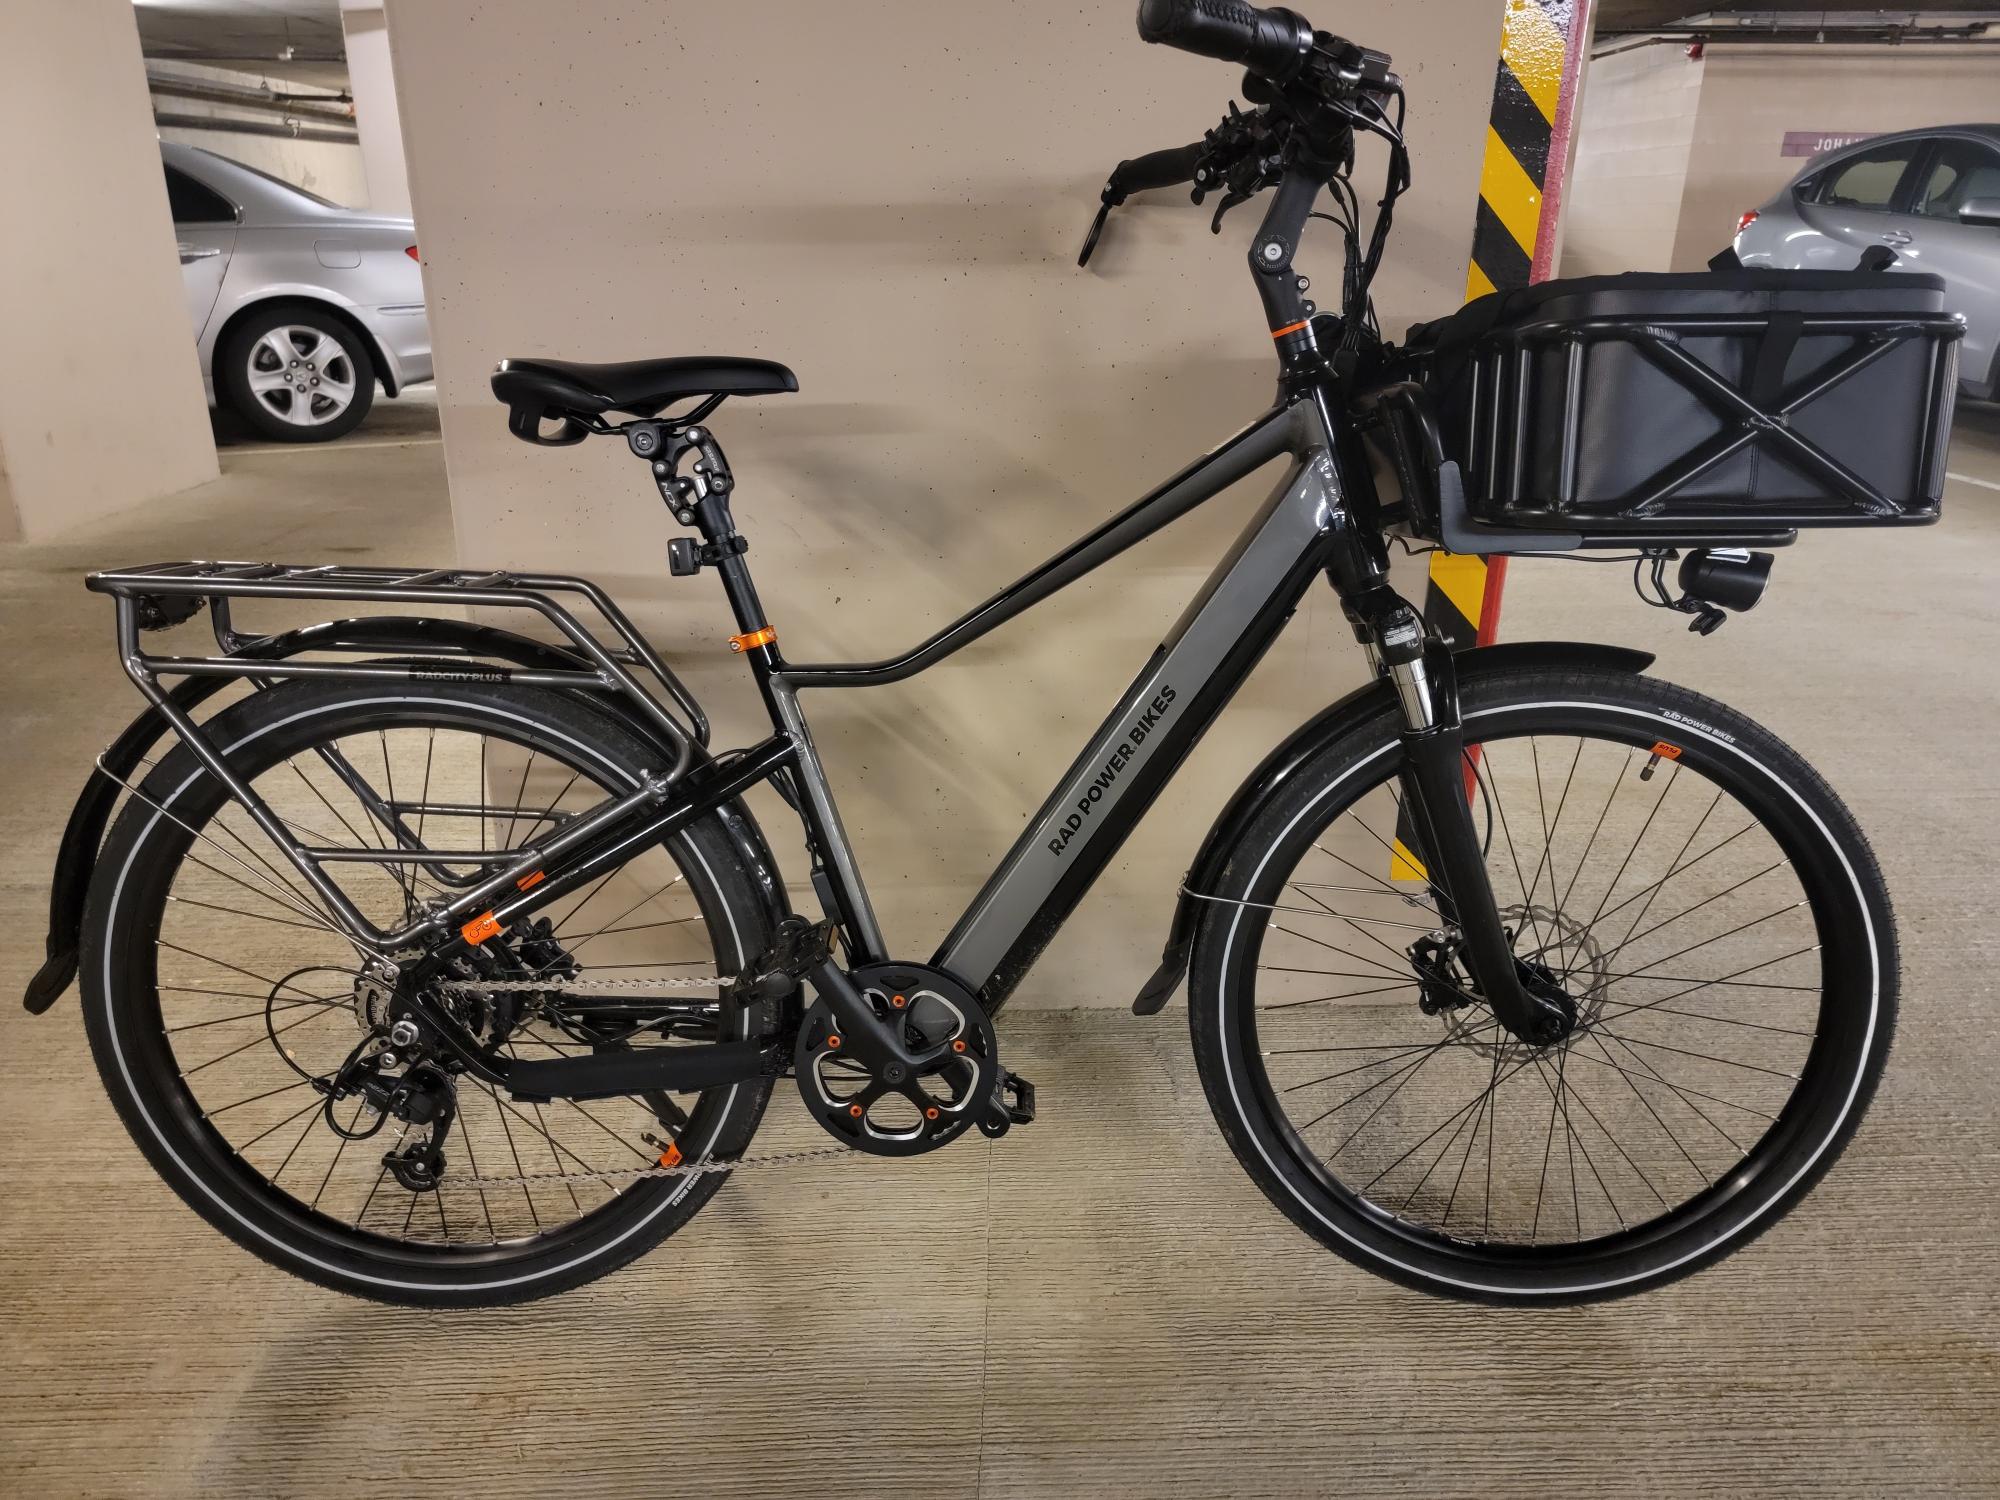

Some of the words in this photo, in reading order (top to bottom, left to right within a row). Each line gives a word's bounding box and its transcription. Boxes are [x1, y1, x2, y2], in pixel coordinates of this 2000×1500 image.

[416, 671, 471, 681] RADCITY
[472, 673, 503, 682] PLUS
[1662, 711, 1681, 721] RAD
[1681, 717, 1712, 733] POWER
[1712, 729, 1736, 744] BIKES
[1048, 813, 1082, 857] RAD
[1077, 743, 1135, 816] POWER
[1128, 685, 1177, 746] BIKES
[672, 1188, 689, 1206] BIKES
